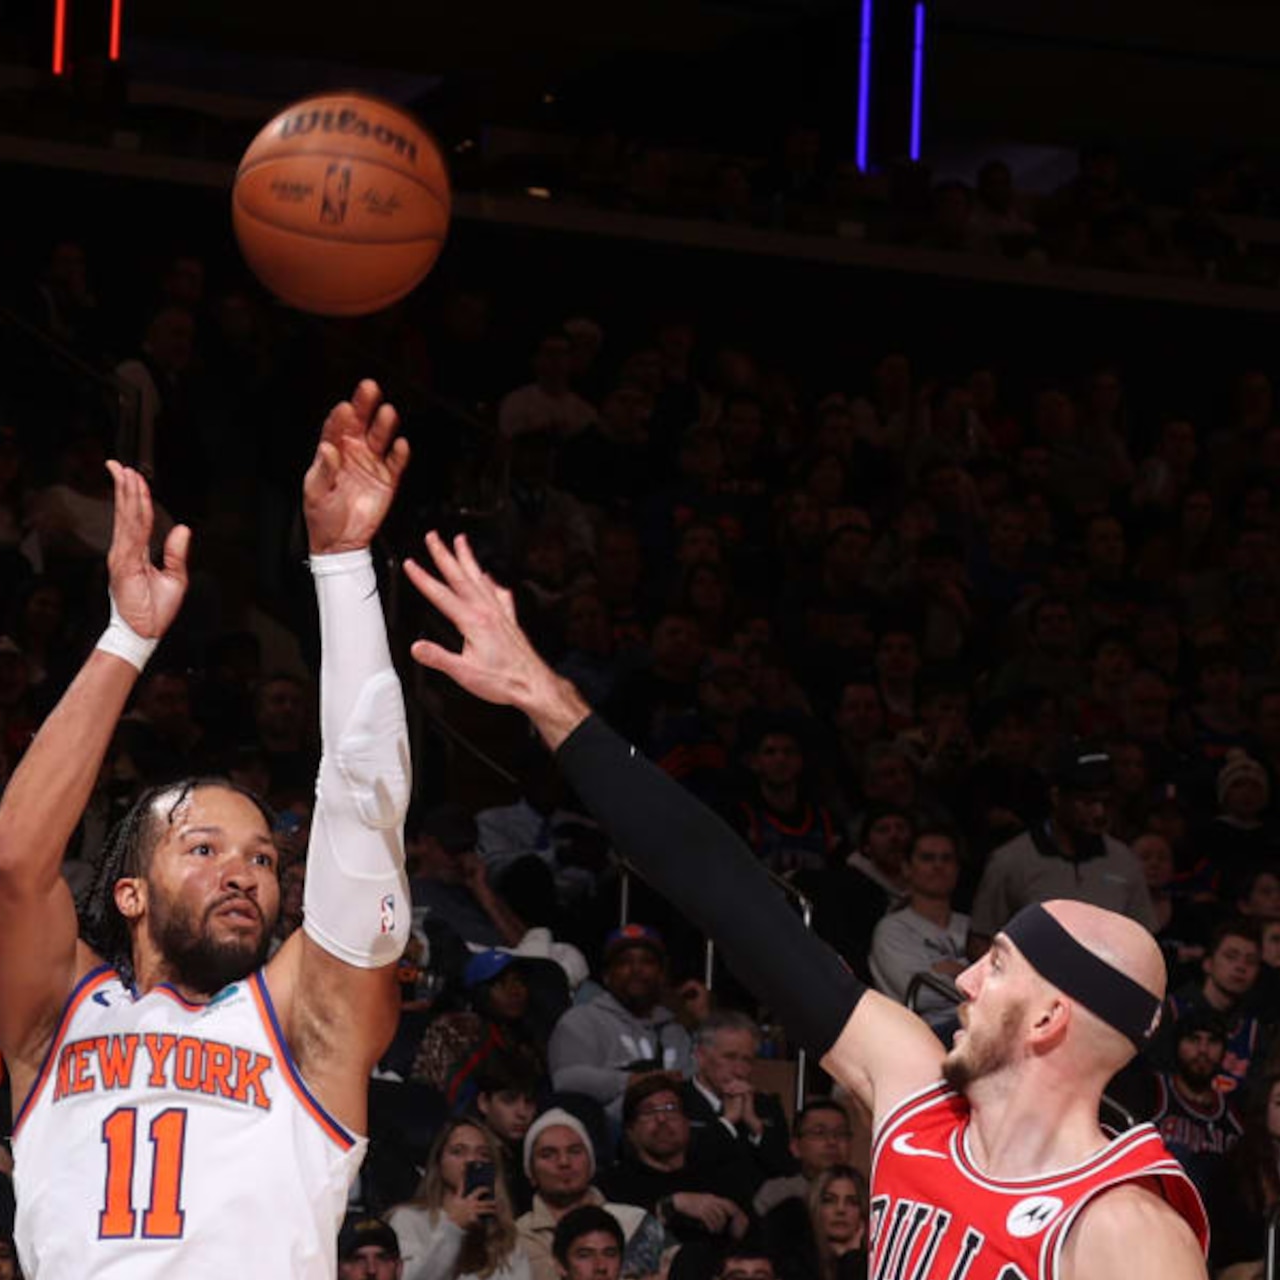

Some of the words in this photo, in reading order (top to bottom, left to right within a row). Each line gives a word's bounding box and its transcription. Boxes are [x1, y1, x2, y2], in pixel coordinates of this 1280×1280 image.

[278, 107, 418, 164] Wilson
[52, 1033, 141, 1106] NEW
[143, 1033, 272, 1113] YORK
[97, 1106, 188, 1241] 11
